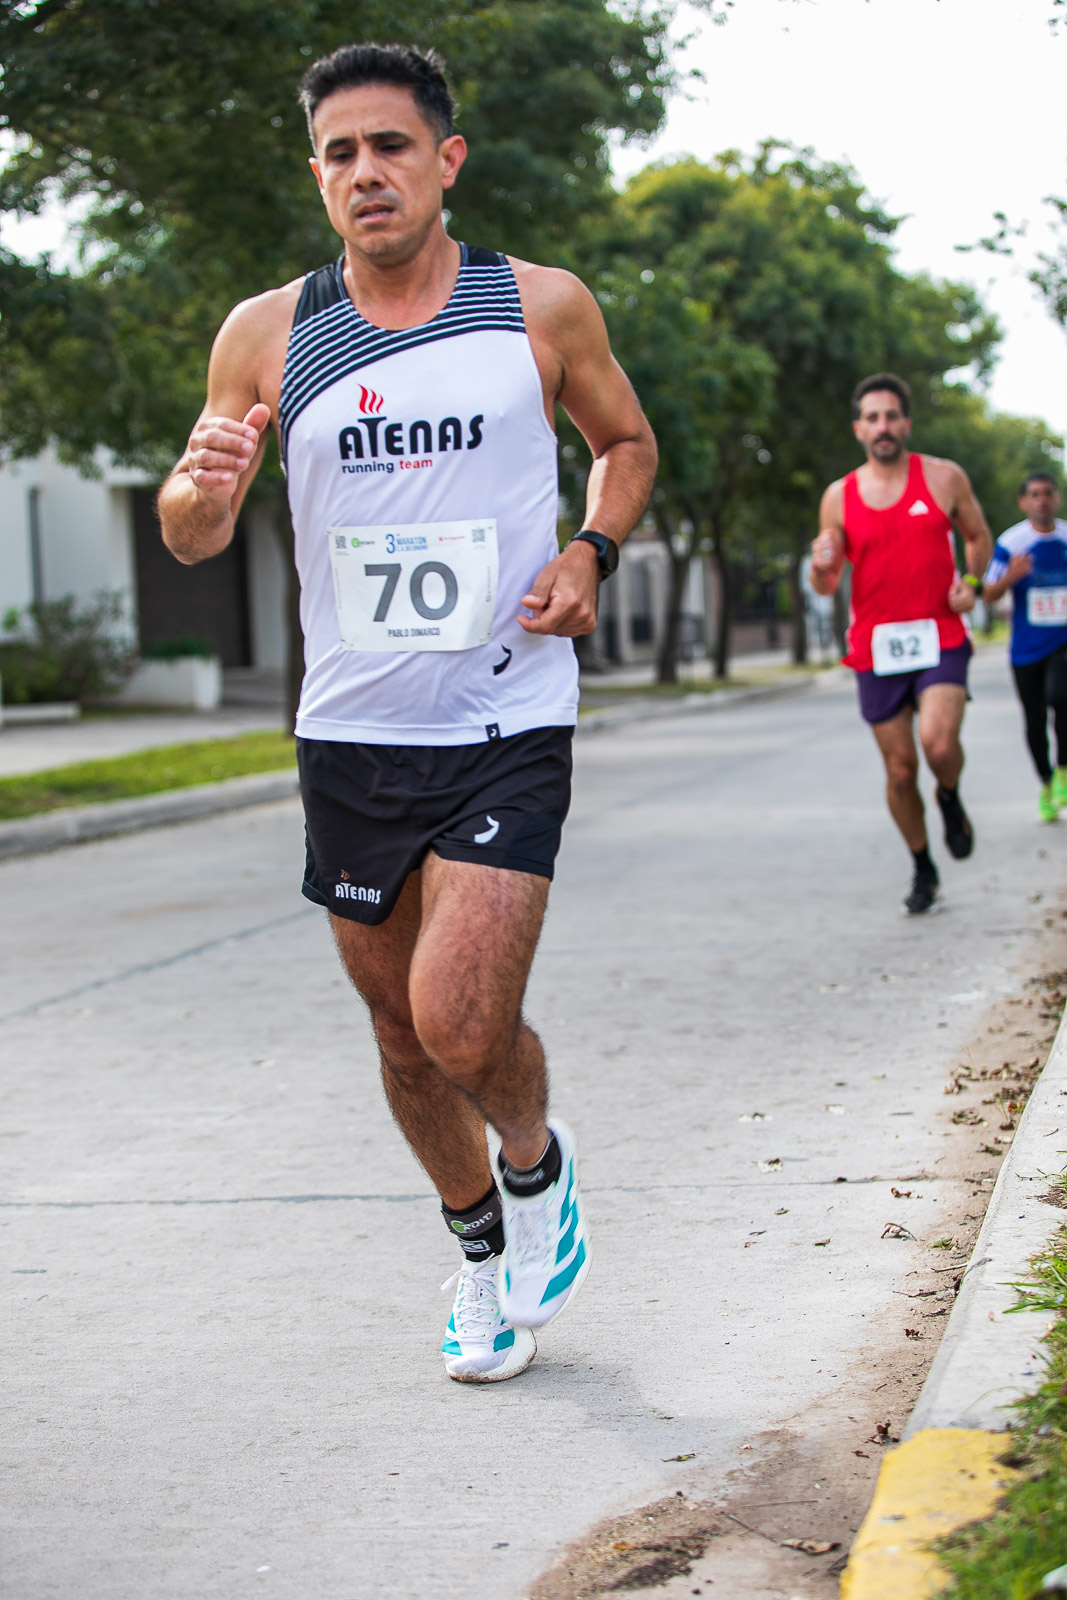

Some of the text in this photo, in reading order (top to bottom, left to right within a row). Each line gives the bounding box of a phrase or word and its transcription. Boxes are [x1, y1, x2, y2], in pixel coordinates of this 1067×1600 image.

[338, 414, 484, 460] ATENAS
[342, 459, 433, 473] running team
[364, 561, 458, 622] 70
[388, 627, 440, 637] PABLO DIMARCO
[889, 636, 921, 658] 82
[335, 882, 381, 904] ATENAS
